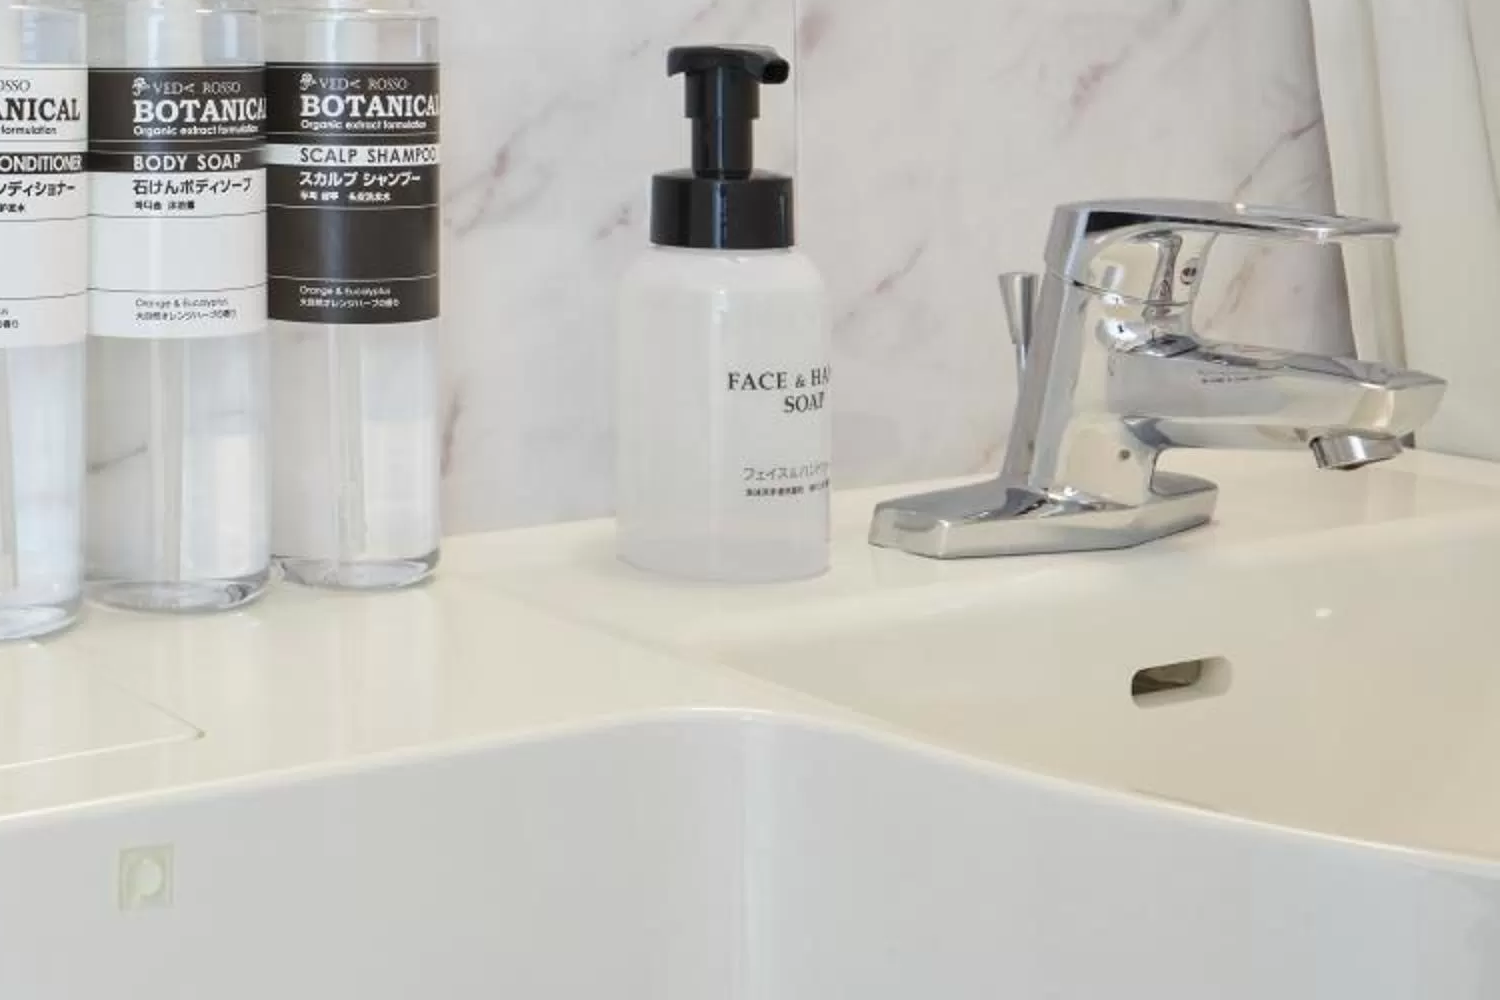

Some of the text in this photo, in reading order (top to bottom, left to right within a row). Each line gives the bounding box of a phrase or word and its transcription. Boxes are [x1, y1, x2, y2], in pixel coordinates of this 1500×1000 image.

[202, 81, 241, 95] ROSSO
[368, 77, 408, 90] ROSSO
[0, 124, 57, 135] formulation
[133, 125, 177, 137] Organic
[180, 125, 216, 135] extract
[301, 119, 342, 131] Organic
[345, 120, 381, 130] extract
[133, 153, 242, 171] BODY SOAP
[300, 147, 437, 163] SCALP SHAMPOO
[300, 171, 421, 187] スカルプ シャンプー
[728, 364, 831, 391] FACE & HA
[783, 391, 825, 414] SOAP
